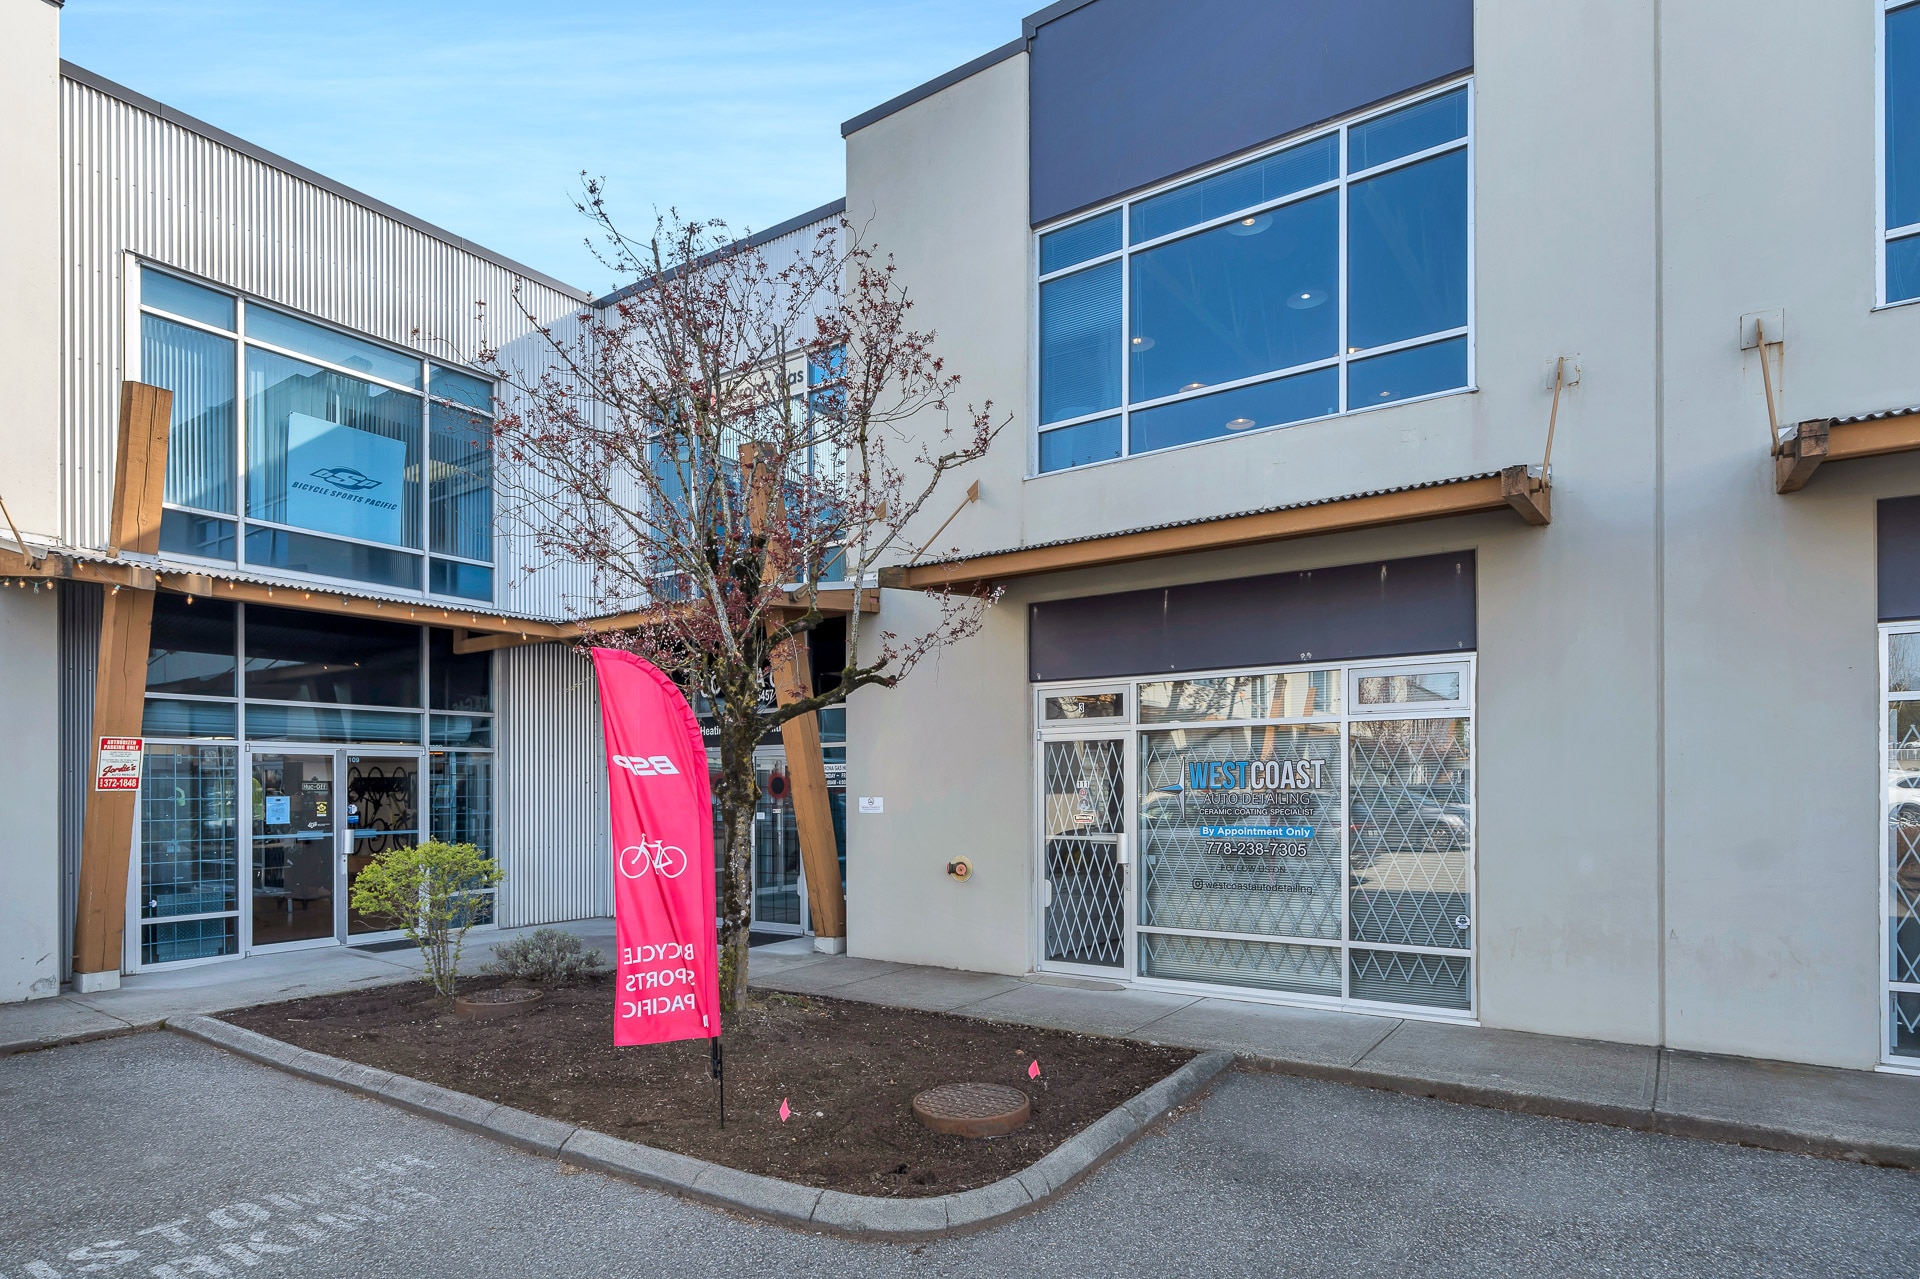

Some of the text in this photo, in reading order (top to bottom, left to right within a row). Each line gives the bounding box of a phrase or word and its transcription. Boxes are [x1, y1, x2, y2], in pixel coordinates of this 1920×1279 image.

[291, 481, 398, 511] BICYCLE SPORTS PACIFIC
[1079, 703, 1085, 713] 3
[103, 778, 137, 788] 372-1848
[1203, 792, 1310, 806] AUTO DETAILING
[1199, 808, 1314, 817] CERAMIC COATING SPECIALIST
[1202, 827, 1311, 838] By Appointment Only
[1205, 841, 1308, 858] 778-238-7305
[1220, 864, 1286, 874] FOLLOW US ON
[1205, 881, 1313, 896] westcoastautodetailing
